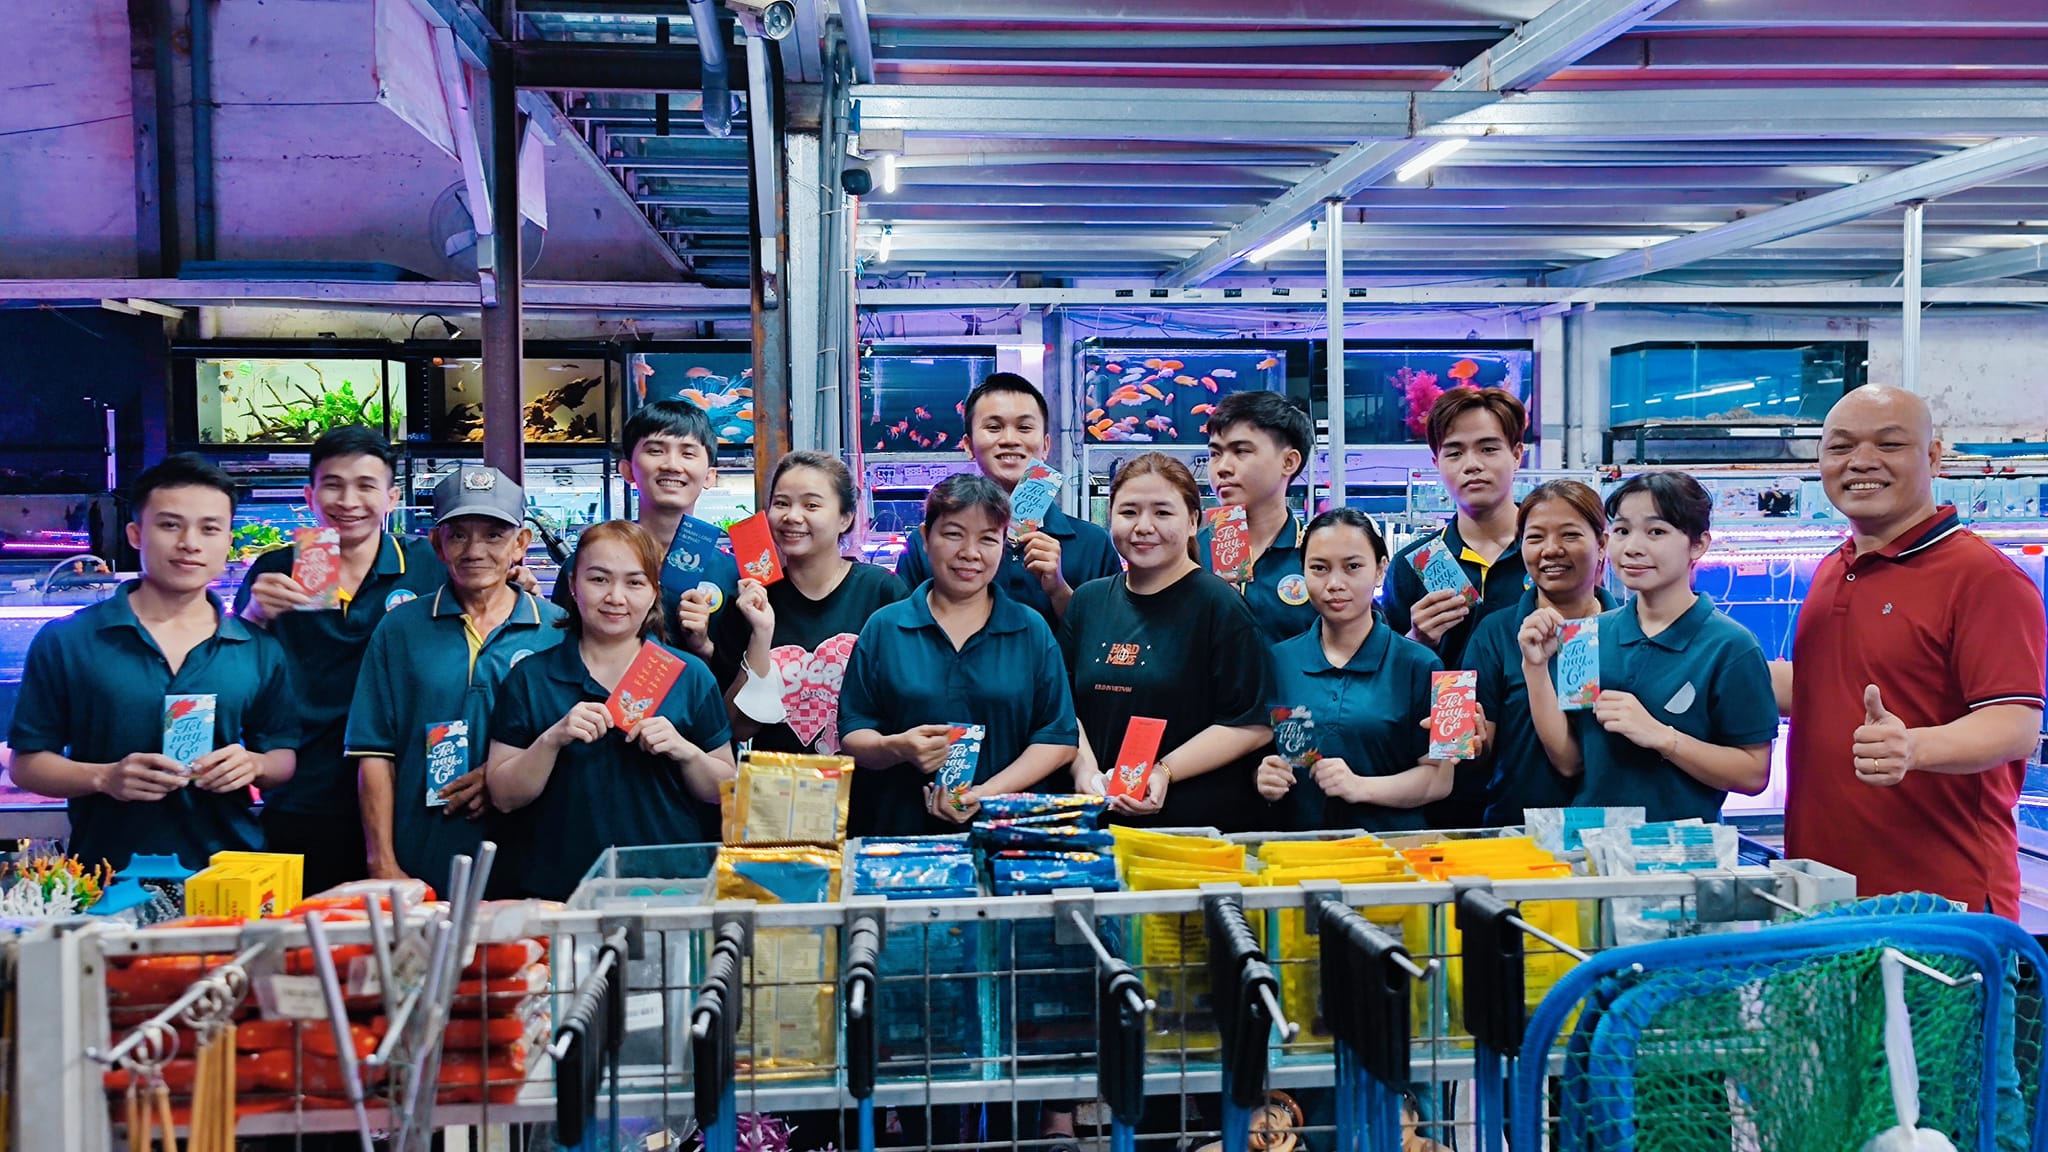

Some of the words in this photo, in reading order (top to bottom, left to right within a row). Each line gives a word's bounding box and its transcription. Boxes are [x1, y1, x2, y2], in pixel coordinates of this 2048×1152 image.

[1216, 538, 1240, 553] nay
[1215, 548, 1240, 566] Cá
[1438, 692, 1464, 709] Tết
[1436, 707, 1464, 723] nay
[1434, 718, 1462, 736] Cá
